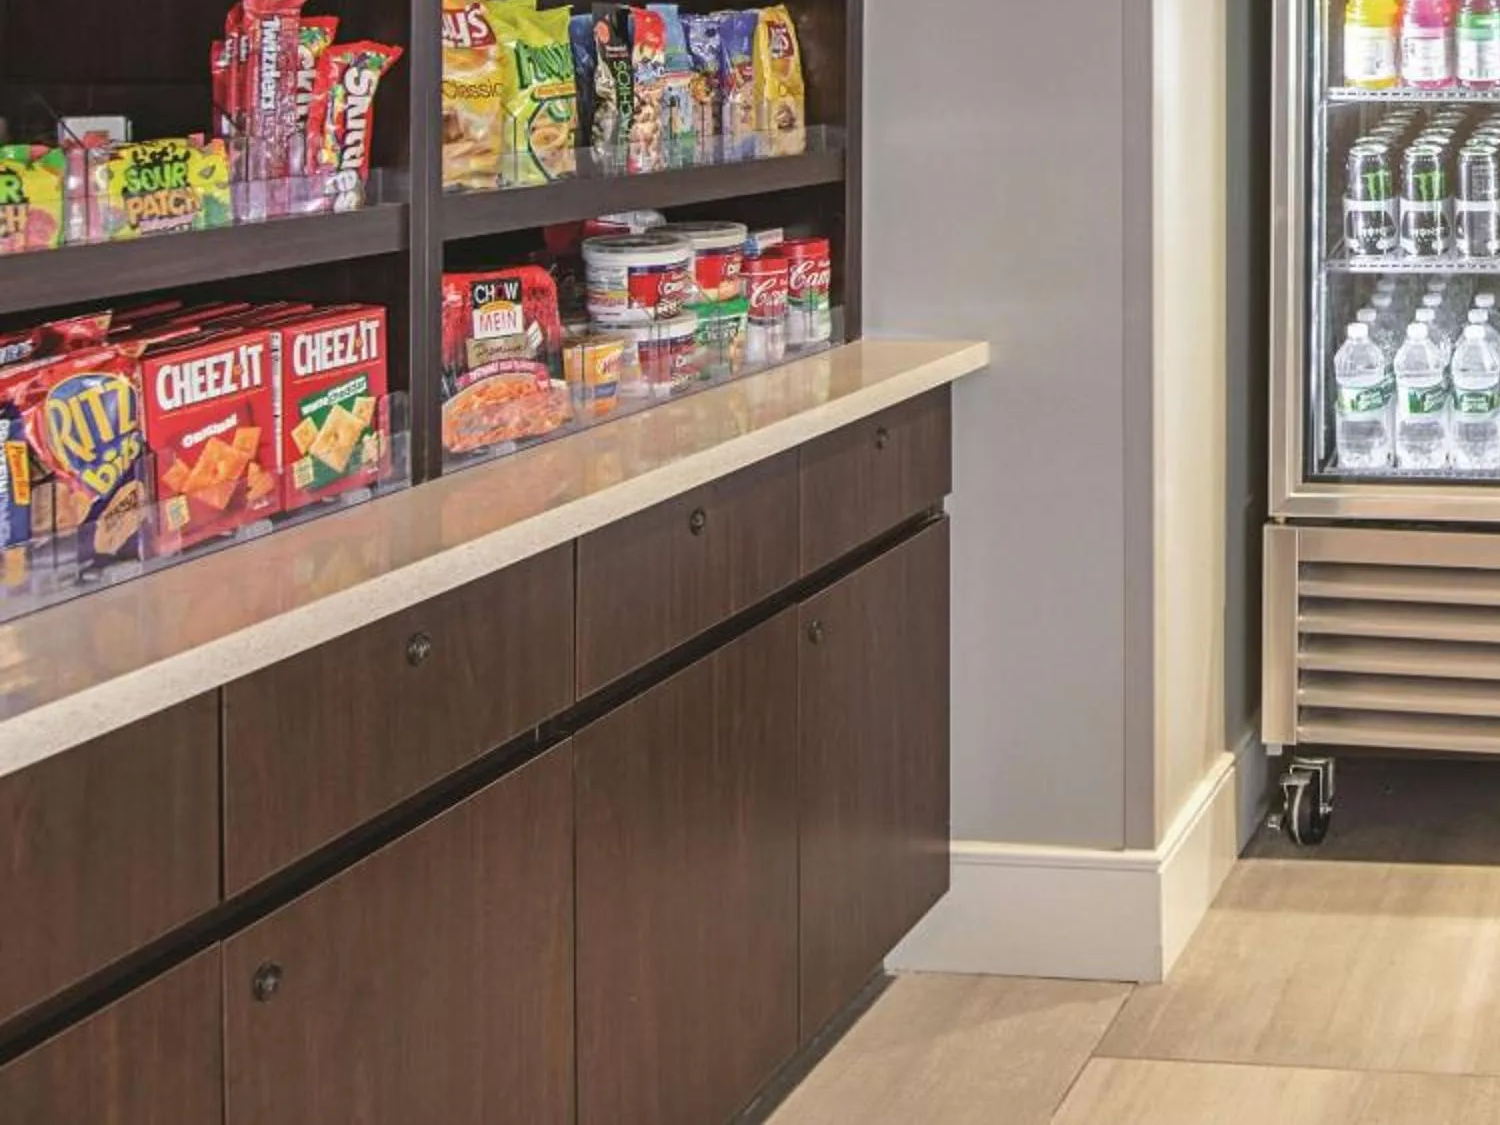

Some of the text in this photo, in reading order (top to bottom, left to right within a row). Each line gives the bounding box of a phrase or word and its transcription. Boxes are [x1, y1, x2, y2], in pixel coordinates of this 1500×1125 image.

[126, 161, 187, 194] SOUR
[480, 311, 517, 333] MEIN
[49, 379, 137, 463] RITZ
